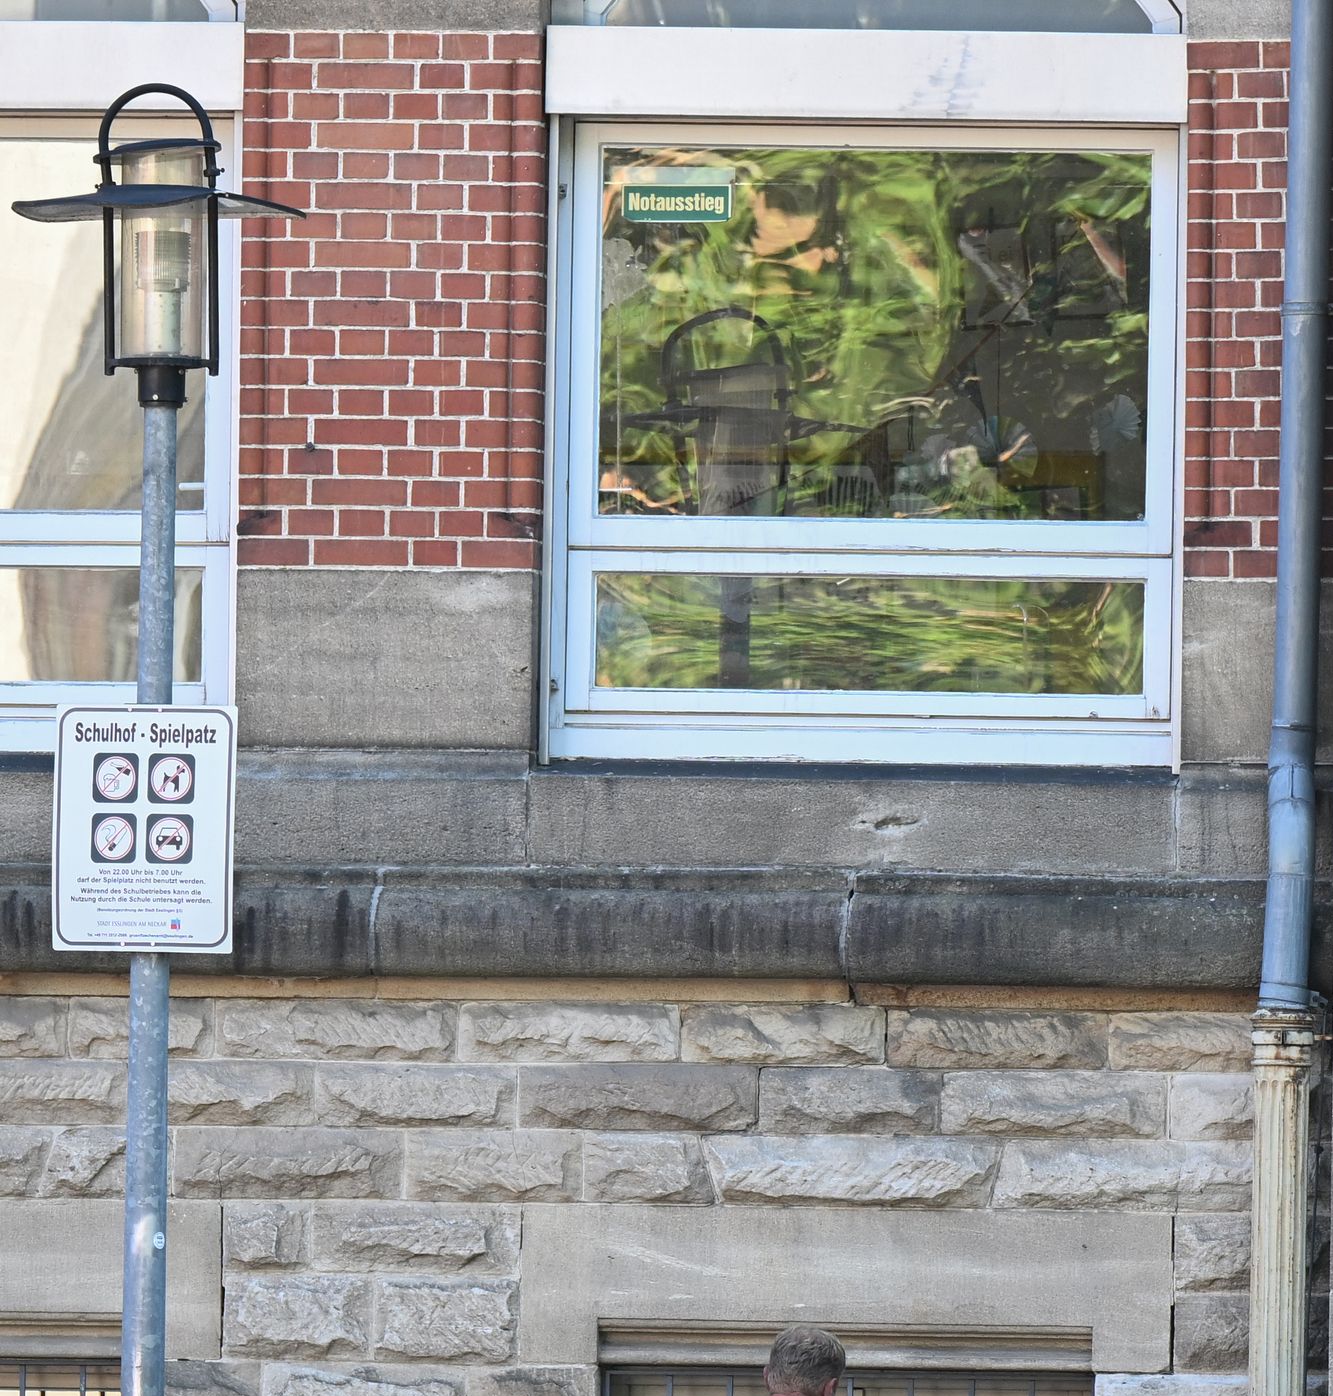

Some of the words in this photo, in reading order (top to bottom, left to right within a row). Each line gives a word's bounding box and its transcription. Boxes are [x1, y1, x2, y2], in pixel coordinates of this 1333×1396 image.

[628, 192, 725, 215] Notausstieg
[75, 722, 137, 743] Schulhof
[149, 722, 217, 749] Spielpatz
[130, 868, 143, 876] Uhr
[170, 869, 184, 877] Uhr
